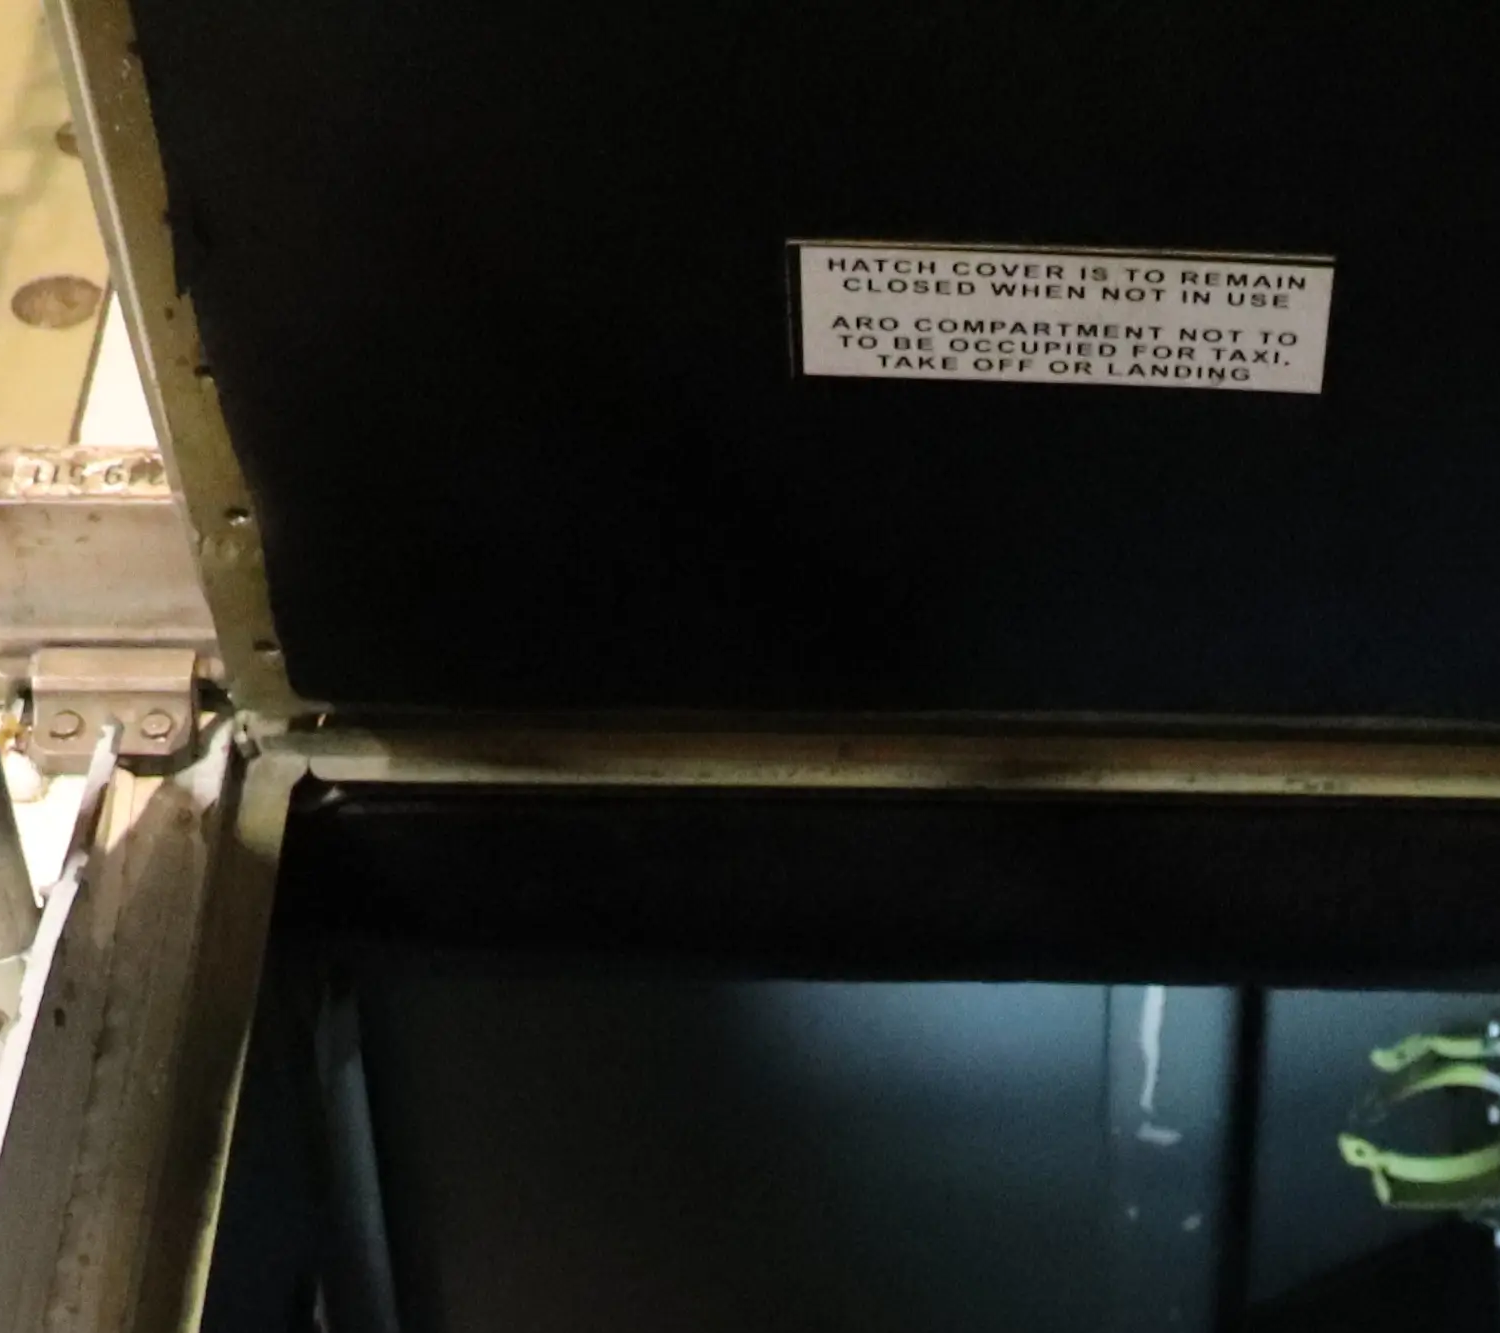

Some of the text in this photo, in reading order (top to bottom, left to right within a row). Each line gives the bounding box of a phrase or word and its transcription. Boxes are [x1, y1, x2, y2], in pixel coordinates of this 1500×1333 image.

[827, 257, 1307, 291] HATCH COVER IS TO REMAIN
[842, 277, 1289, 309] CLOSED WHEN NOT IN USE
[831, 315, 1298, 347] ARO COMPARTMENT NOT TO
[838, 334, 879, 350] TO
[892, 335, 934, 352] BE
[948, 337, 1117, 358] OCCUPIED
[1131, 343, 1196, 361] FOR
[876, 353, 1251, 383] TAKE OFF OR LANDING
